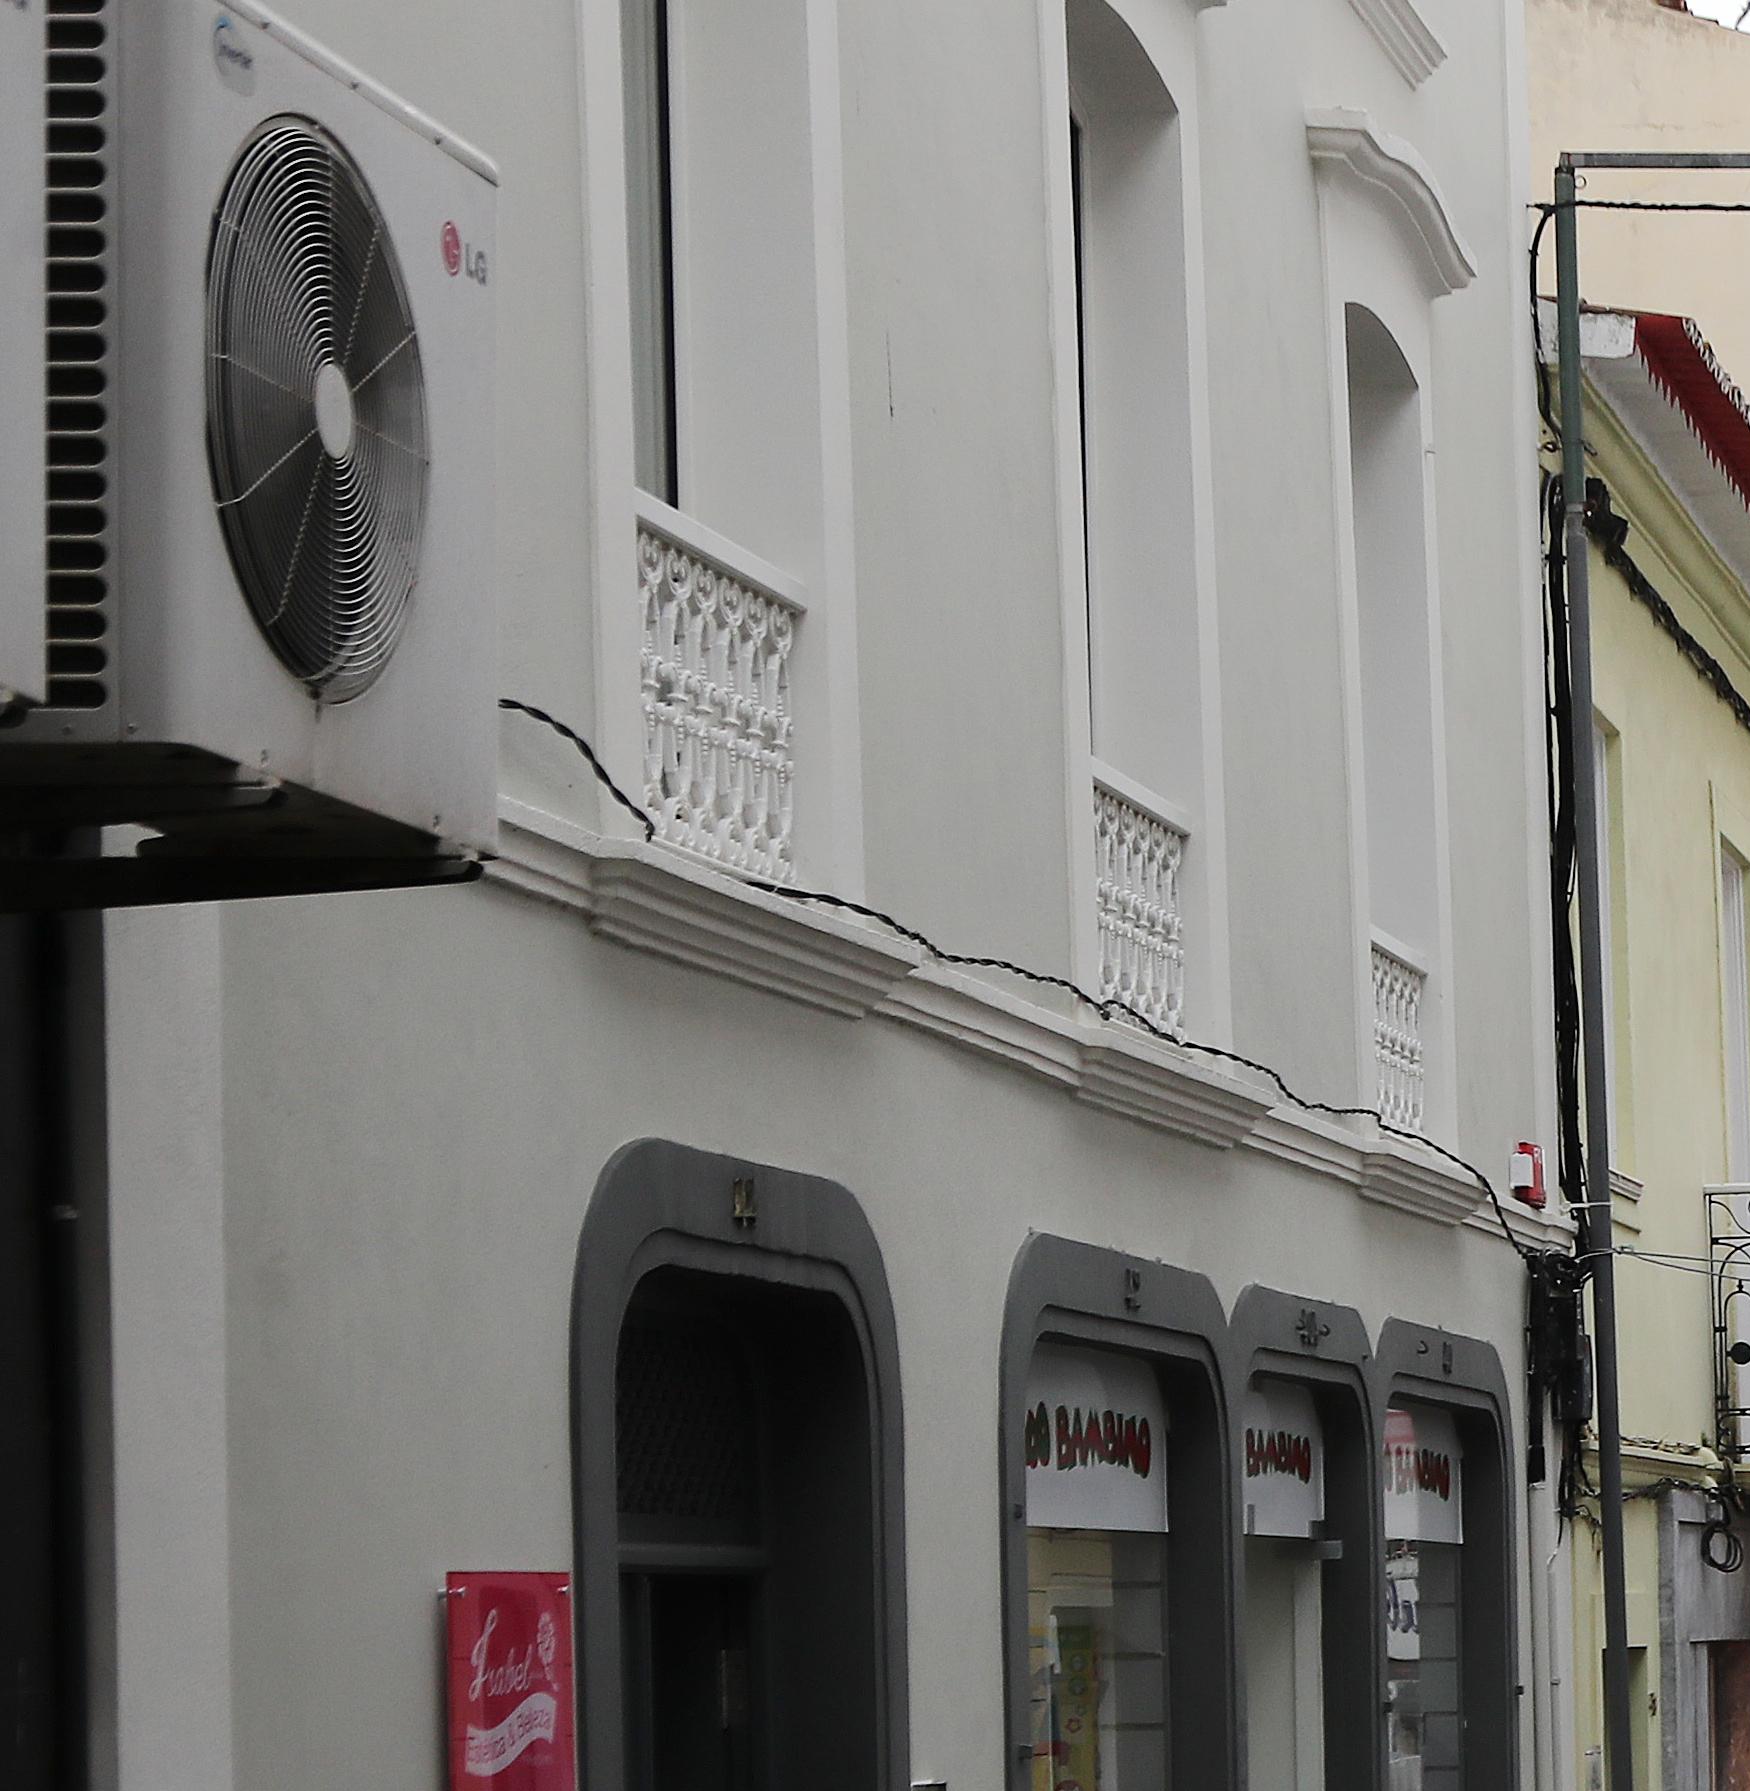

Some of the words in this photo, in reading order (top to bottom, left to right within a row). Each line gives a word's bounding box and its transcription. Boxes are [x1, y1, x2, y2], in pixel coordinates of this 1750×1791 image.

[465, 242, 488, 286] LG
[1054, 1404, 1152, 1479] BAMBINO
[1245, 1427, 1312, 1485] BAMBINO
[469, 1608, 534, 1702] Isabel
